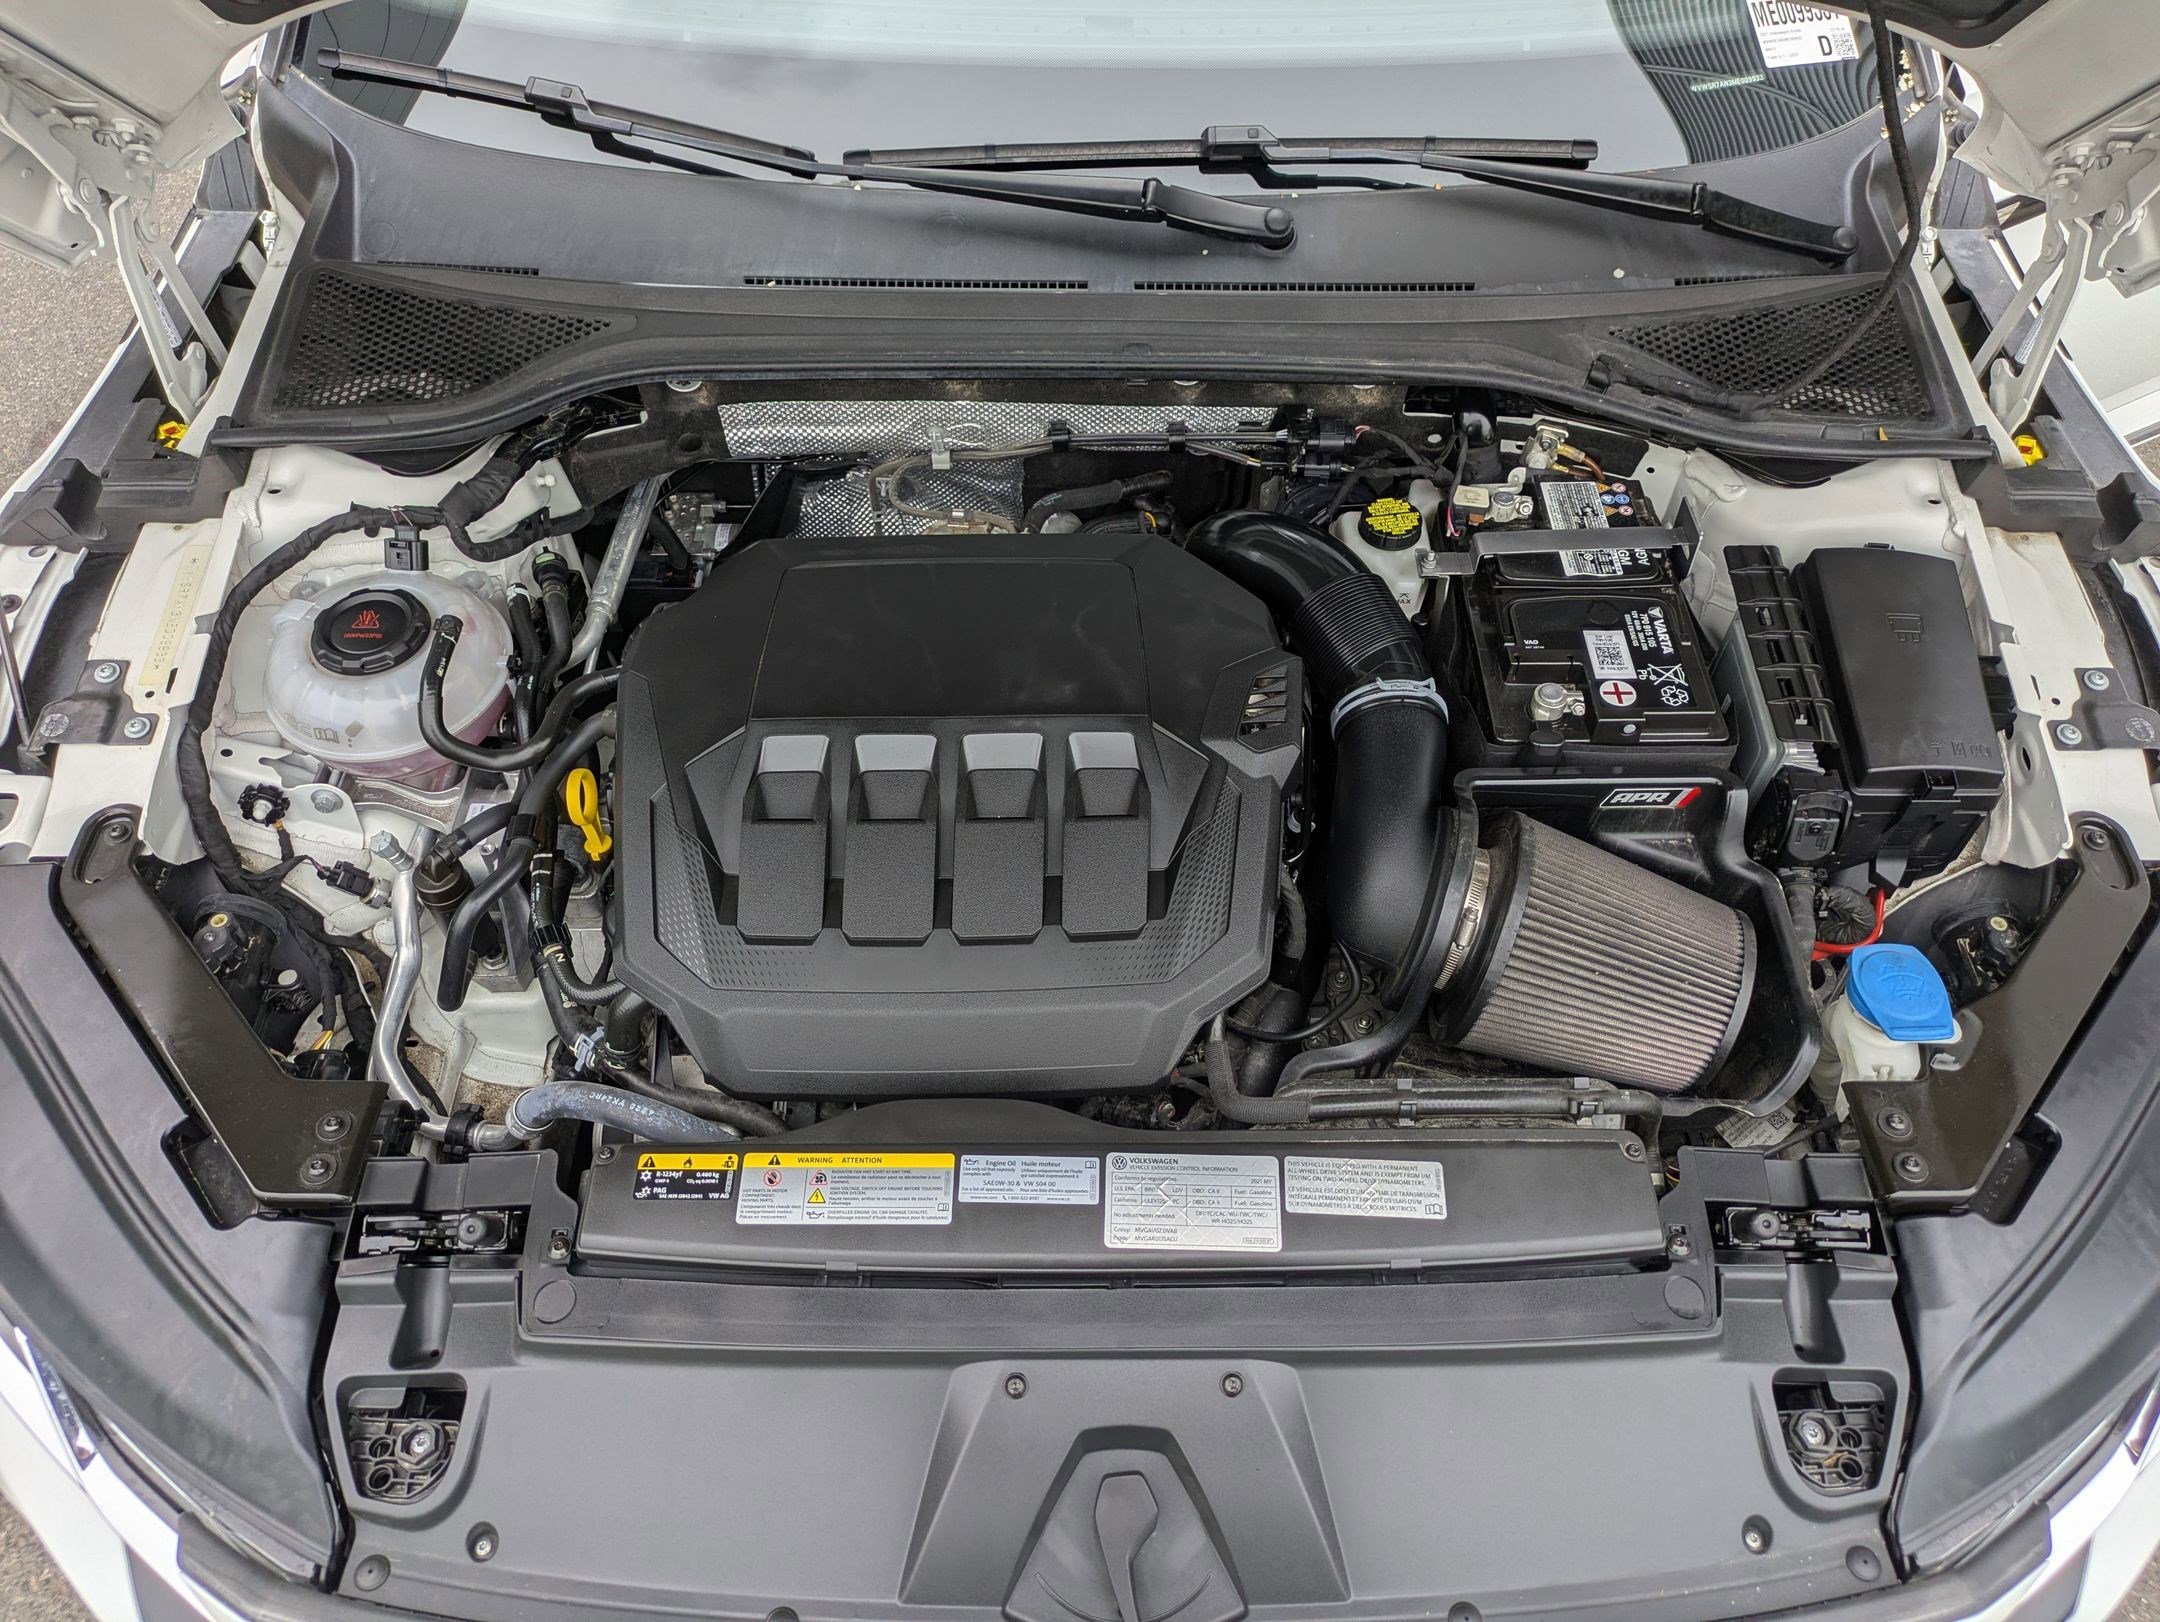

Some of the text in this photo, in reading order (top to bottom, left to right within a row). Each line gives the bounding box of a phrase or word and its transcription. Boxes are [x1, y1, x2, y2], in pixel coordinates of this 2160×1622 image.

[1817, 35, 1833, 56] D
[1643, 625, 1653, 636] 915
[1646, 637, 1656, 647] 105
[1654, 619, 1674, 654] VARTA
[1637, 669, 1648, 680] Pb
[1610, 792, 1670, 804] APR
